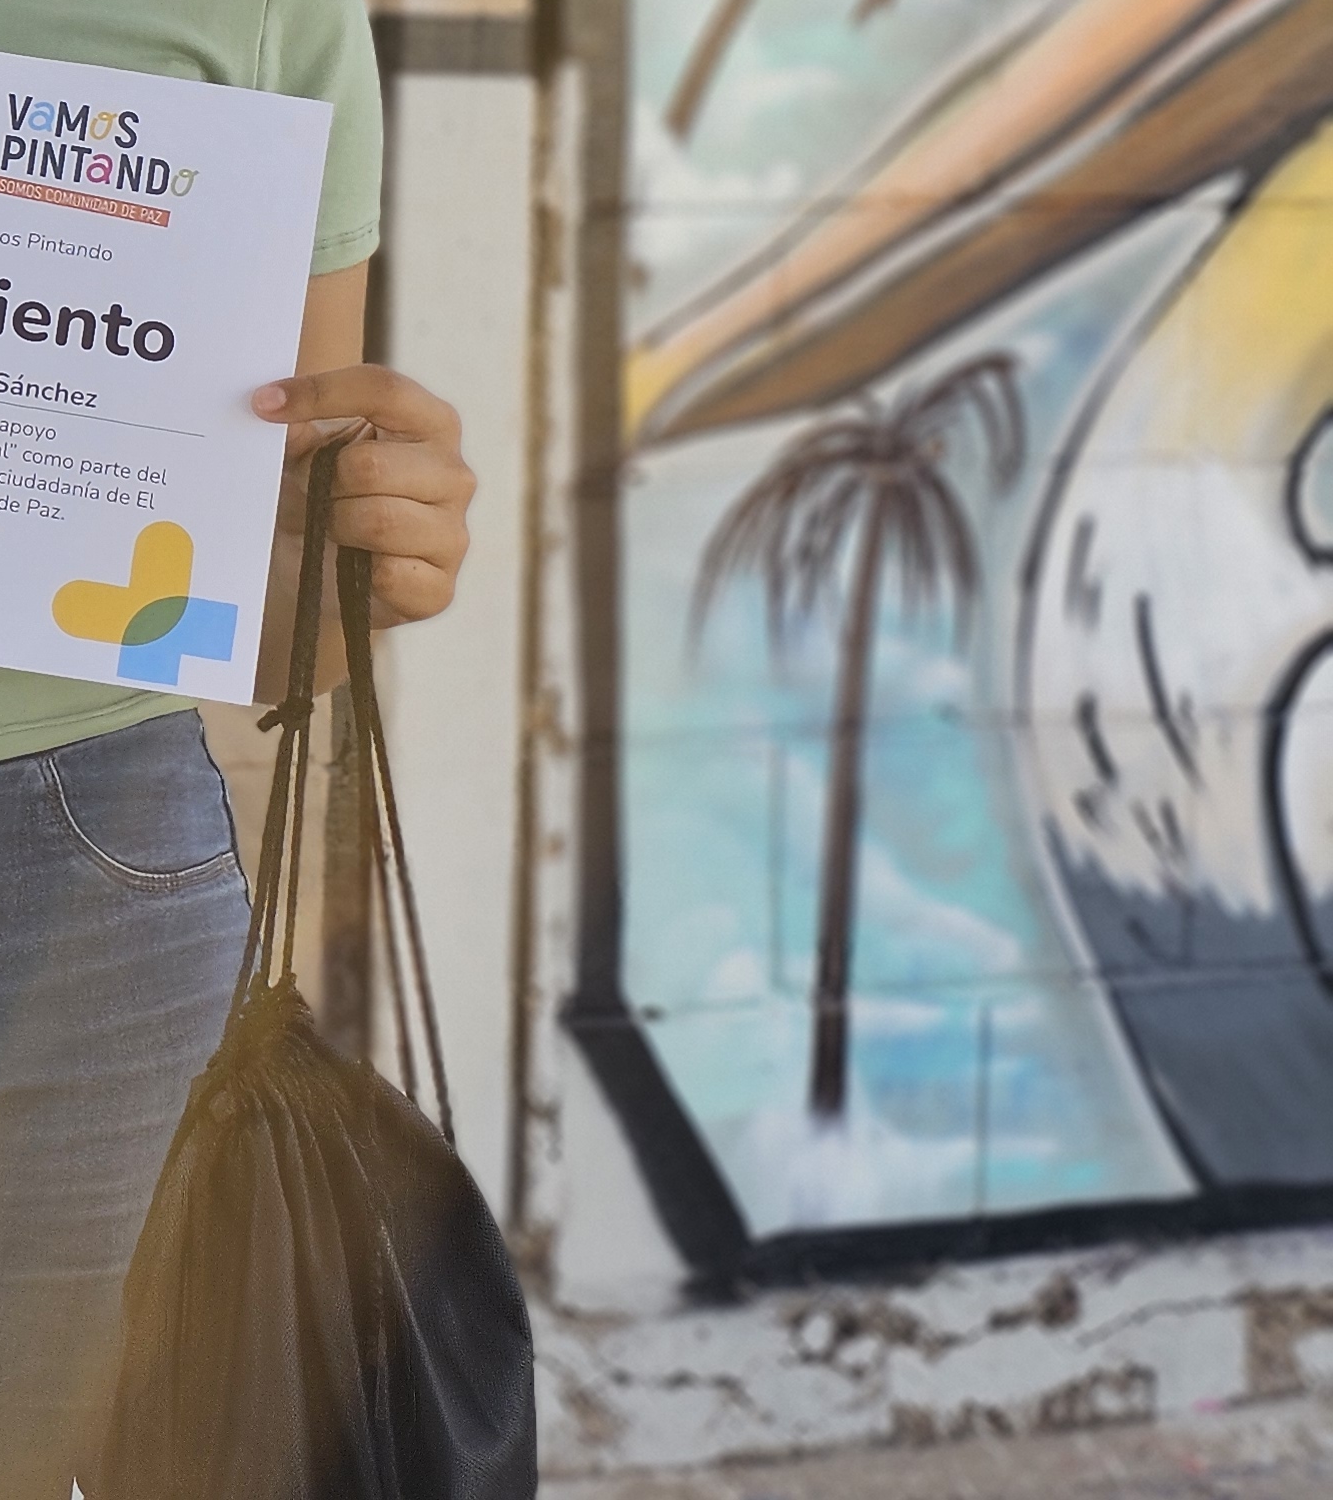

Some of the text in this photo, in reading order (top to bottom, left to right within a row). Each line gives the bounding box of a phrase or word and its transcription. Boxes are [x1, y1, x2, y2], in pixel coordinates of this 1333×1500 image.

[45, 188, 117, 214] COMUNIDAD
[120, 204, 136, 219] DE
[140, 209, 163, 224] PAZ
[27, 232, 113, 262] Pintando
[22, 450, 74, 470] como
[79, 460, 131, 480] parte
[137, 465, 167, 486] del
[26, 498, 65, 521] Paz.
[106, 486, 131, 506] de
[136, 490, 155, 511] El
